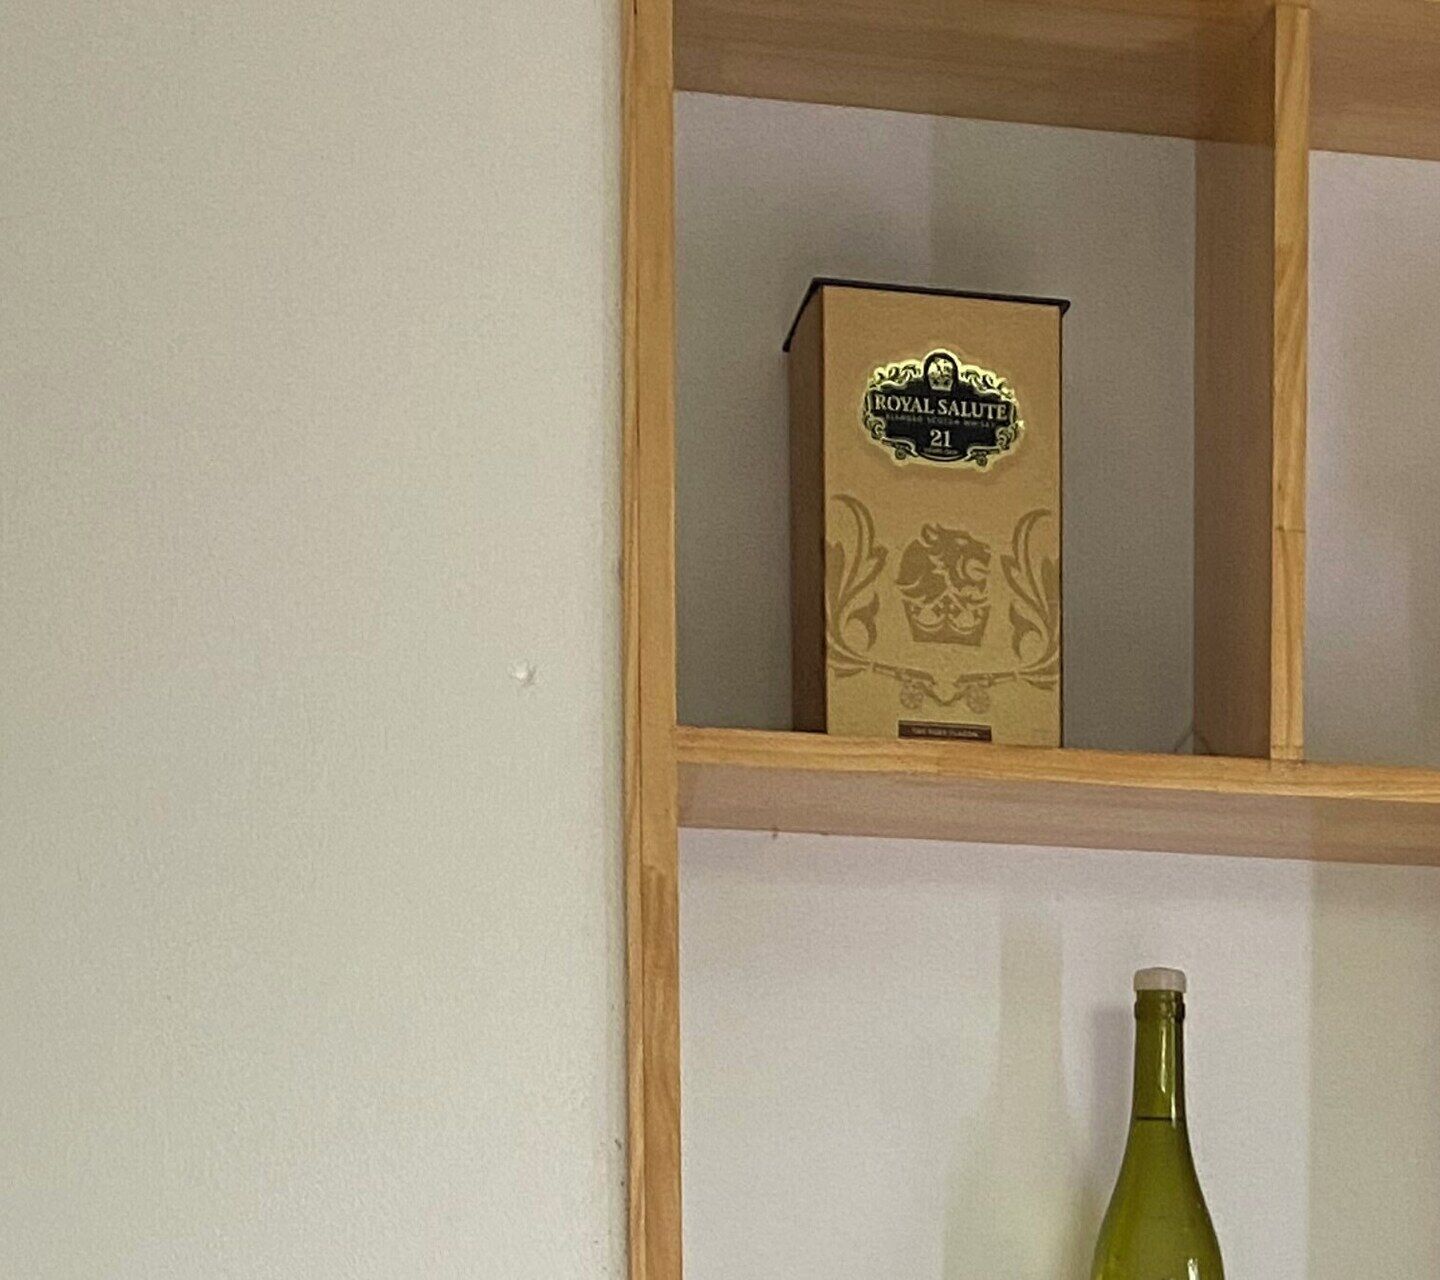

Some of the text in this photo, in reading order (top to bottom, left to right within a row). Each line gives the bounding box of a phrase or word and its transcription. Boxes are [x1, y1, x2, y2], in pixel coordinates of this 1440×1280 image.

[875, 394, 1008, 420] ROYAL SALUTE
[929, 428, 952, 448] 21
